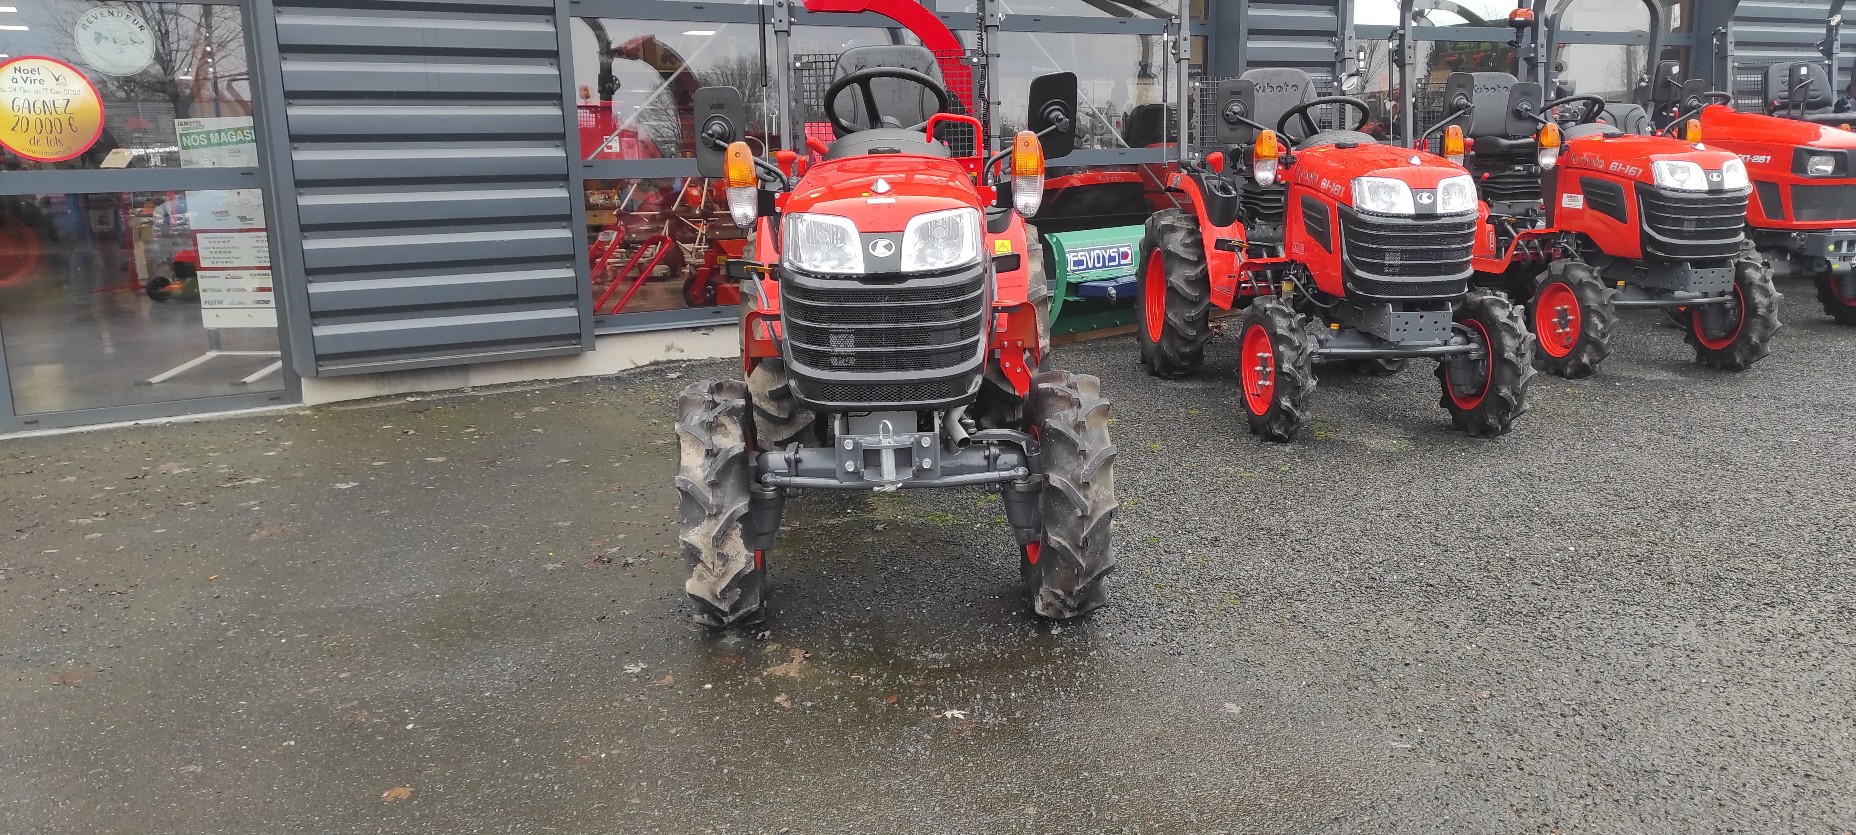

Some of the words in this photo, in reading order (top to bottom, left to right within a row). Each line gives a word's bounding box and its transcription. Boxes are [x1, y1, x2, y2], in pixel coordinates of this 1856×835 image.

[81, 10, 146, 31] REVENDEUR
[13, 65, 41, 76] Noël
[11, 76, 18, 84] à
[20, 76, 45, 86] Vire
[11, 96, 74, 116] GAGNEZ
[11, 114, 30, 134] 20
[34, 117, 63, 135] 000
[67, 115, 79, 133] €
[29, 135, 41, 147] de
[46, 135, 64, 148] lots
[183, 134, 208, 147] NOS
[1609, 161, 1643, 178] B1-161
